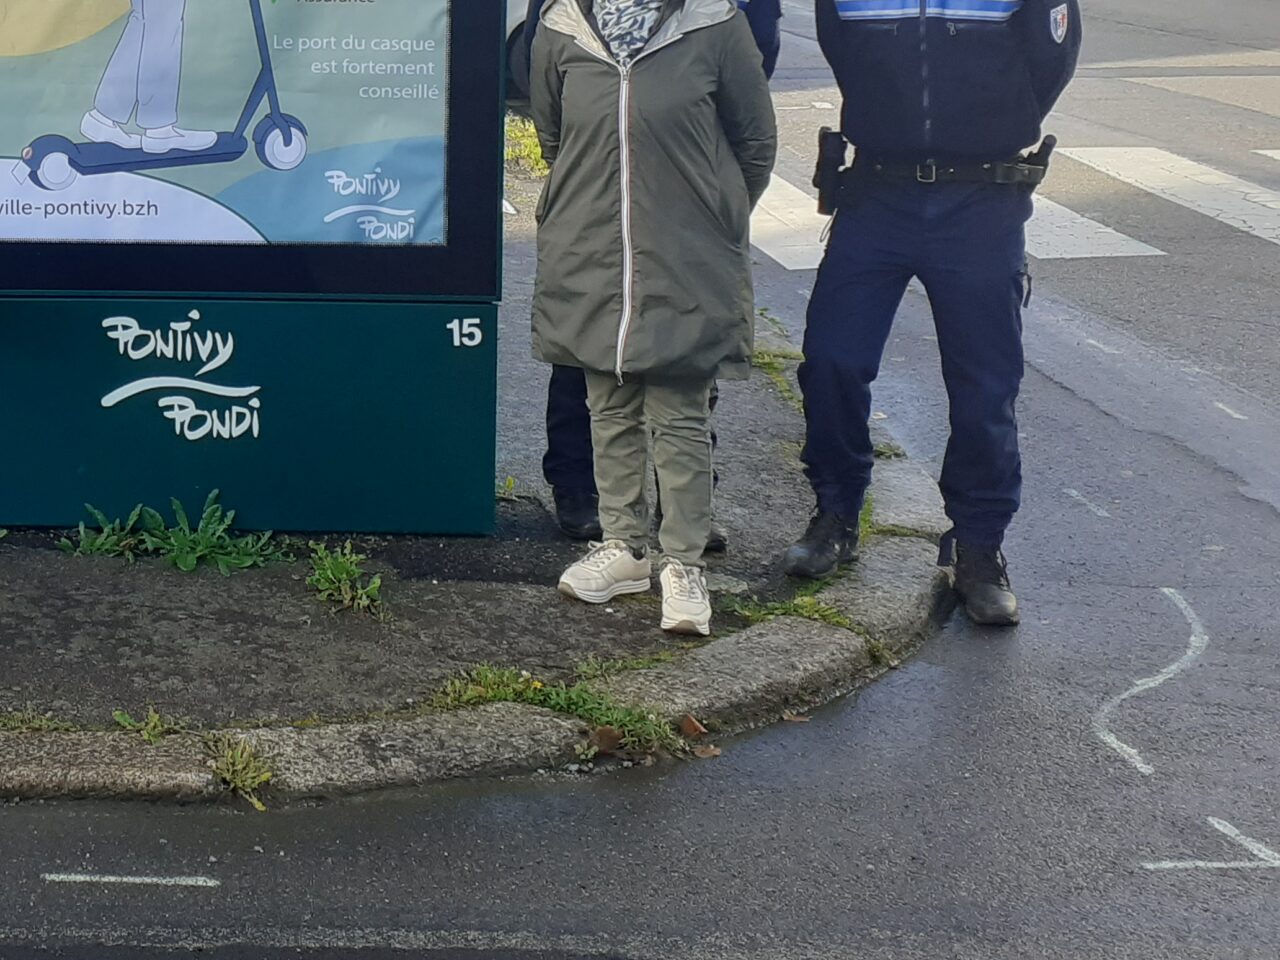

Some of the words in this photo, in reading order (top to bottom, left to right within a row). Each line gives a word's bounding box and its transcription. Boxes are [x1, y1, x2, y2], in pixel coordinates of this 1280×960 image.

[272, 34, 294, 50] Le
[298, 35, 337, 53] port
[341, 33, 366, 52] du
[370, 37, 436, 54] casque
[311, 60, 337, 75] est
[342, 58, 436, 76] fortement
[358, 82, 440, 100] conseillé
[446, 318, 483, 347] 15
